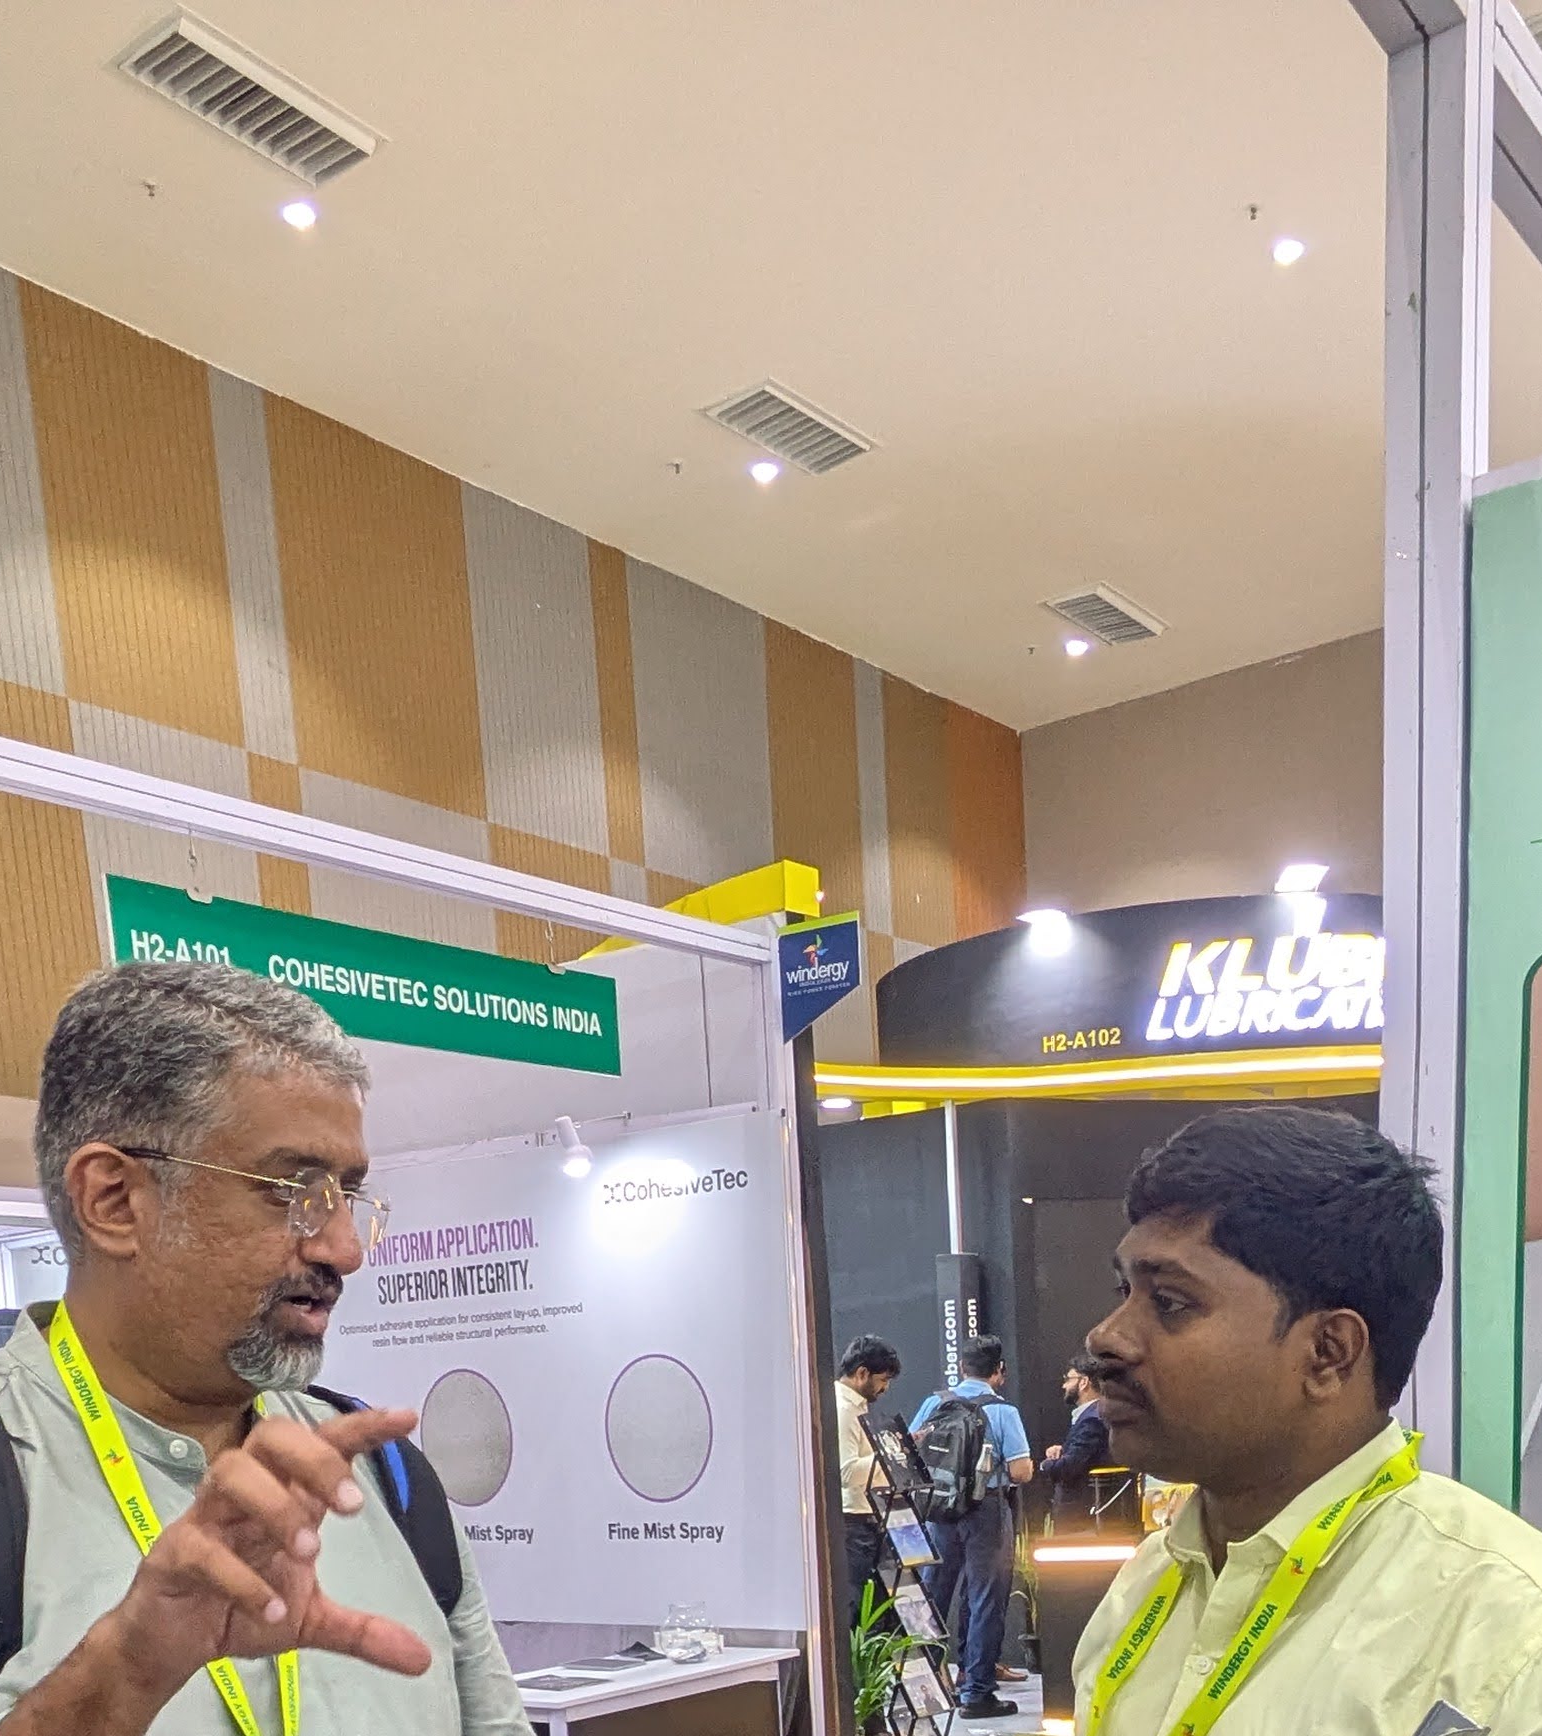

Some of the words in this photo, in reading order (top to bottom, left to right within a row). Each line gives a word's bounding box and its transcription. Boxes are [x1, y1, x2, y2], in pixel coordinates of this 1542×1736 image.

[786, 957, 849, 985] windergy
[268, 953, 429, 1009] COHESIVETEC
[433, 984, 549, 1028] SOLUTIONS
[552, 1005, 603, 1037] INDIA
[1042, 1027, 1122, 1055] H2-A102
[366, 1230, 434, 1268] UNIFORM
[436, 1216, 540, 1259] APPLICATION.
[376, 1269, 449, 1306] SUPERIOR
[452, 1259, 535, 1297] INTEGRITY.
[379, 1319, 413, 1333] adhesive
[414, 1316, 457, 1332] application
[458, 1313, 469, 1325] for
[470, 1310, 512, 1324] consistent
[542, 1302, 583, 1318] improved
[409, 1332, 425, 1344] and
[455, 1325, 493, 1340] structural
[494, 1322, 549, 1339] performance.
[944, 1299, 959, 1393] eber.com
[66, 1358, 102, 1423] WINDERGY
[464, 1524, 493, 1542] Mist
[494, 1524, 534, 1545] Spray
[607, 1522, 640, 1540] Fine
[643, 1521, 676, 1539] Mist
[679, 1521, 725, 1544] Spray
[1131, 1594, 1168, 1652] WINDERGY
[1106, 1645, 1133, 1680] INDIA
[1207, 1640, 1253, 1702] WINDERGY
[1249, 1601, 1279, 1647] INDIA
